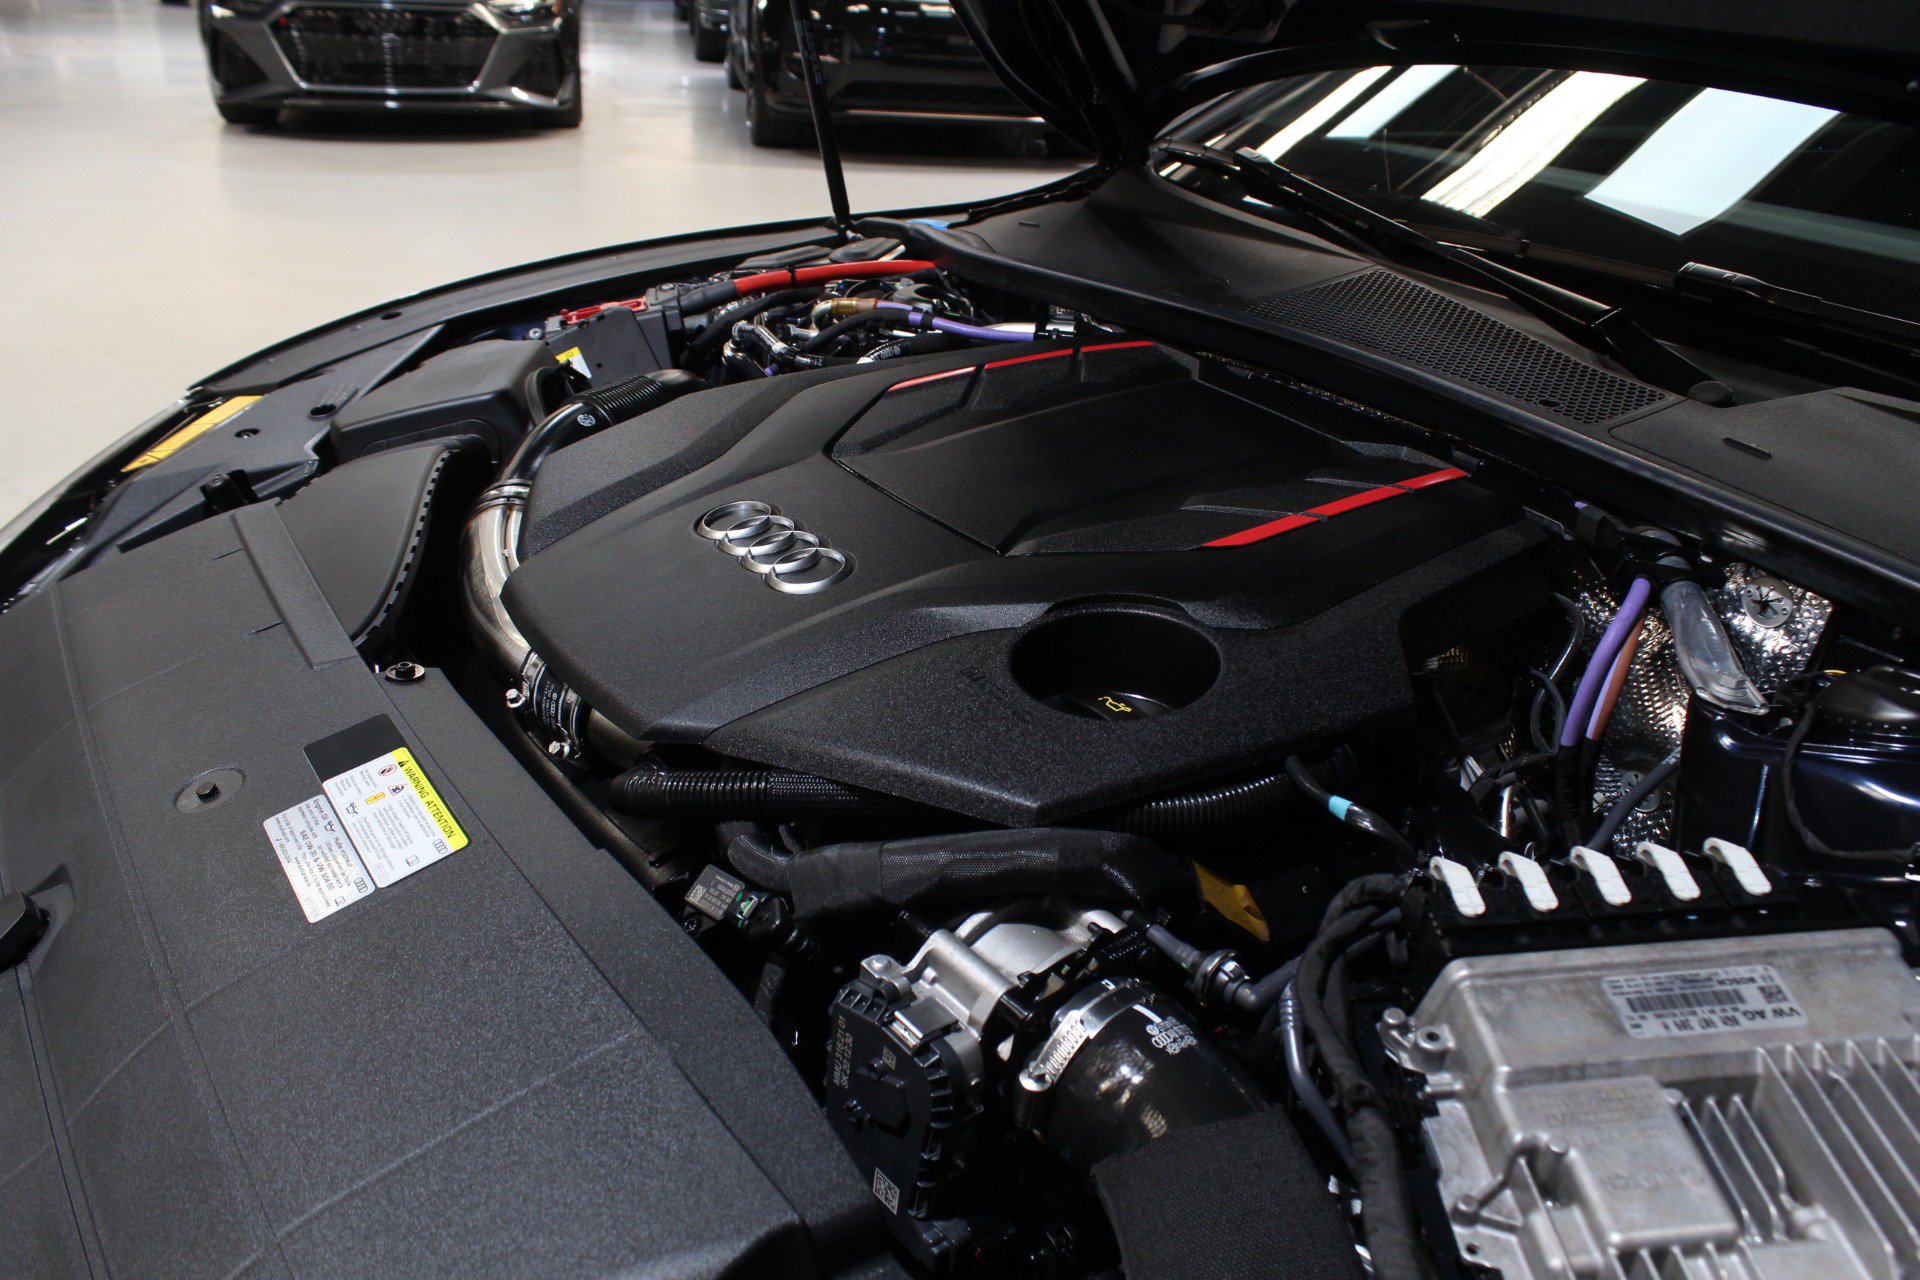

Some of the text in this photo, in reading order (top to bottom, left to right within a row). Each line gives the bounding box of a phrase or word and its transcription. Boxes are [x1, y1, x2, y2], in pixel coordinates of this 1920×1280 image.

[312, 798, 325, 814] Engine
[403, 766, 430, 798] WARNING
[424, 799, 455, 838] ATTENTION
[299, 829, 309, 841] SAE
[315, 862, 325, 872] VW
[332, 836, 354, 868] Huile moteur
[1740, 1009, 1769, 1020] AG
[1769, 1006, 1802, 1018] VW
